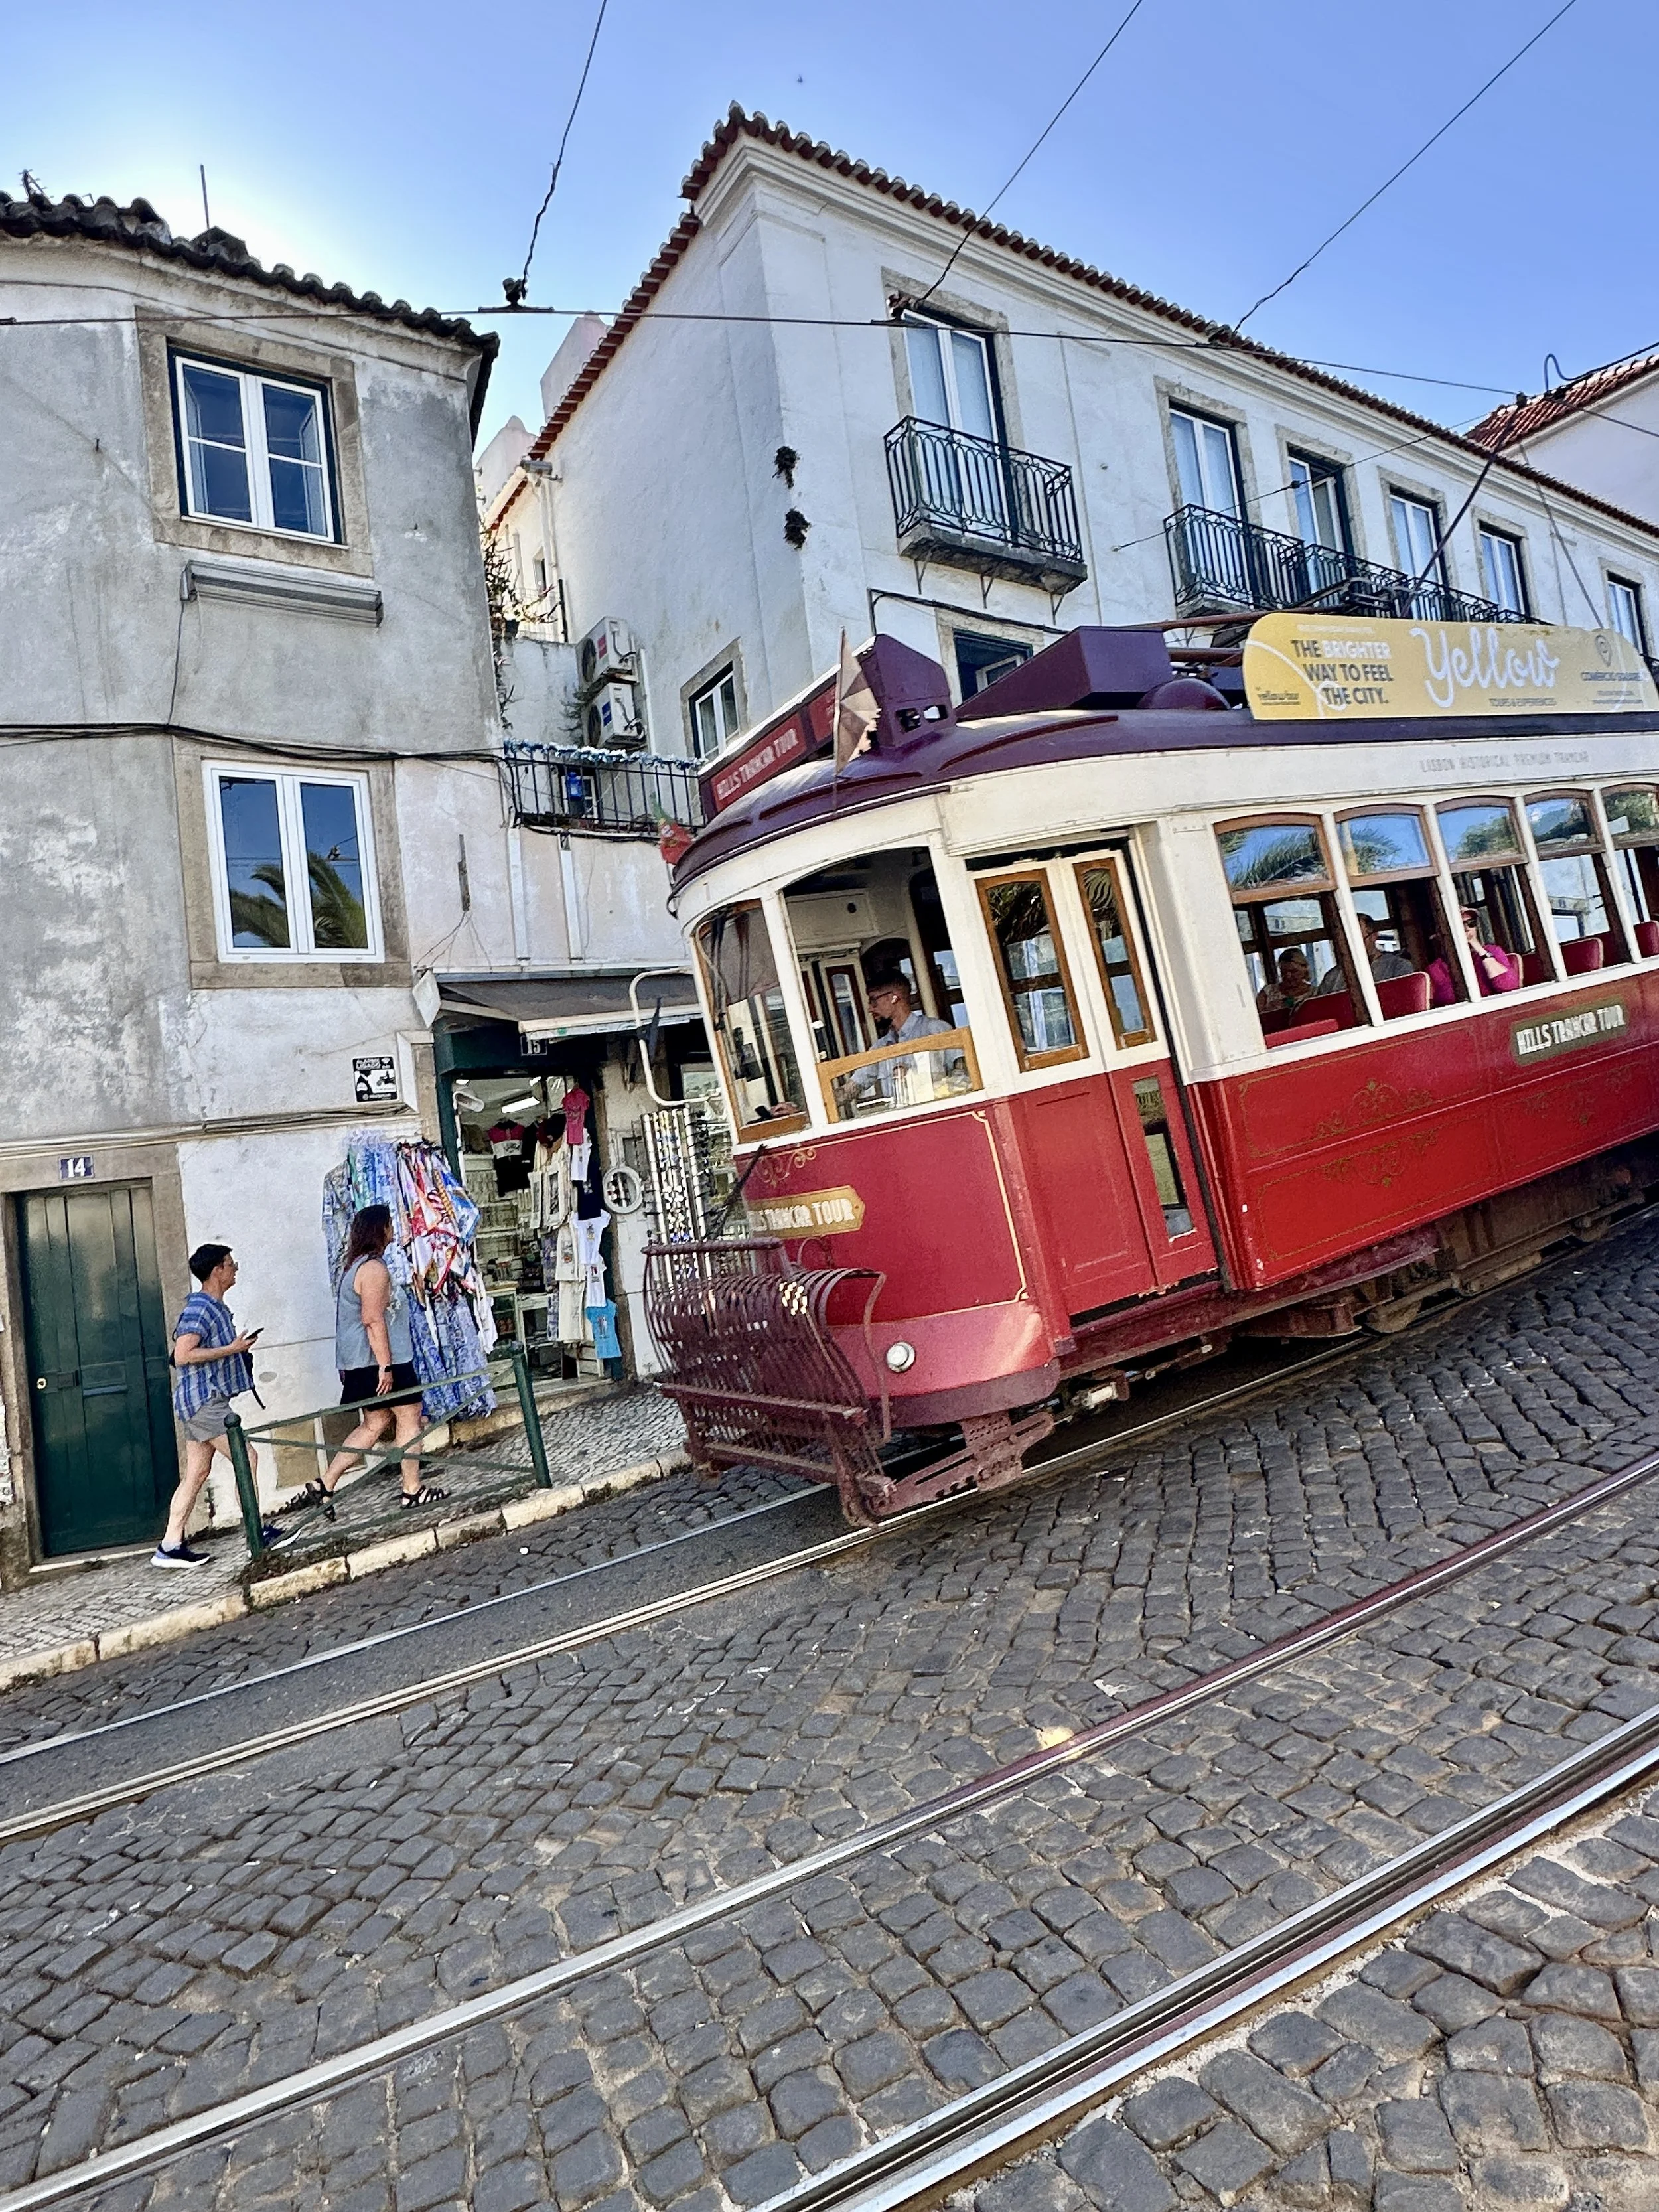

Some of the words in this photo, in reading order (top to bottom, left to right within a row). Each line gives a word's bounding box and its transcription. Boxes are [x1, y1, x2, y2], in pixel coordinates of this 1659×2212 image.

[1291, 640, 1321, 658] THE
[1322, 640, 1392, 659] BRIGHTER
[1303, 664, 1338, 682] WAY
[1340, 664, 1360, 682] TO
[1362, 664, 1394, 682] FEEL
[1409, 625, 1561, 708] Yellow
[1322, 687, 1352, 705] THE
[1352, 687, 1390, 705] CITY.
[1516, 1023, 1551, 1055] HILLS
[1596, 1004, 1626, 1031] TOUR
[67, 1157, 86, 1177] 14
[811, 1198, 856, 1226] TOUR
